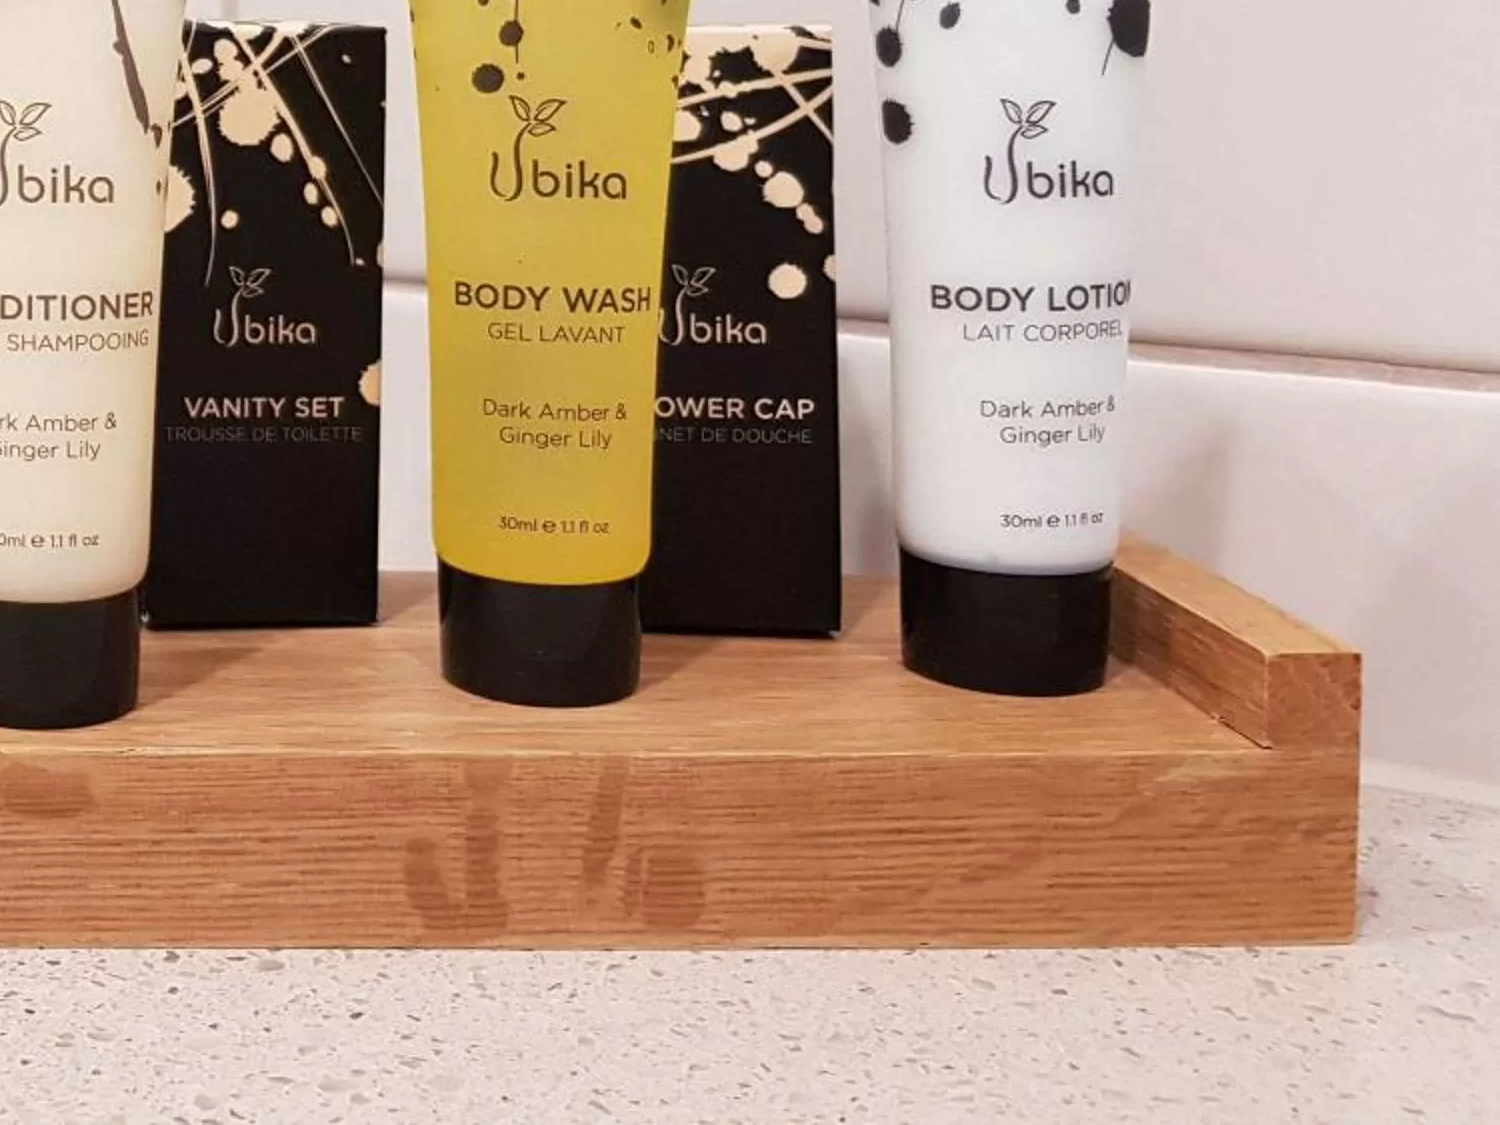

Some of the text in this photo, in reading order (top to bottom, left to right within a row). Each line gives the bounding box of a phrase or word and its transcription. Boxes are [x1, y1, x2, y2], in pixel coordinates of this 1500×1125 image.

[490, 124, 627, 202] Ubika
[984, 125, 1114, 205] Ubika
[454, 281, 652, 313] BODY WASH
[930, 284, 1036, 312] BODY
[213, 289, 317, 347] Ubika
[6, 330, 149, 352] SHAMPOOING
[486, 323, 626, 344] GEL LAVANT
[963, 319, 1123, 342] LAIT CORPOREL
[183, 396, 346, 419] VANITY SET
[483, 398, 628, 421] Dark Amber &
[655, 396, 815, 420] OWER CAP
[979, 399, 1033, 418] Dark
[1040, 399, 1104, 418] Amber
[25, 412, 98, 432] Amber
[104, 412, 118, 430] &
[165, 426, 364, 442] TROUSSE DE TOILETTE
[499, 426, 613, 451] Ginger Lily
[659, 427, 813, 443] NET DE DOUCHE
[999, 424, 1105, 447] Ginger Lily
[66, 440, 101, 461] Lily
[499, 516, 537, 533] 30ml
[593, 521, 609, 533] oz
[999, 512, 1043, 529] 30ml
[82, 534, 100, 547] oz
